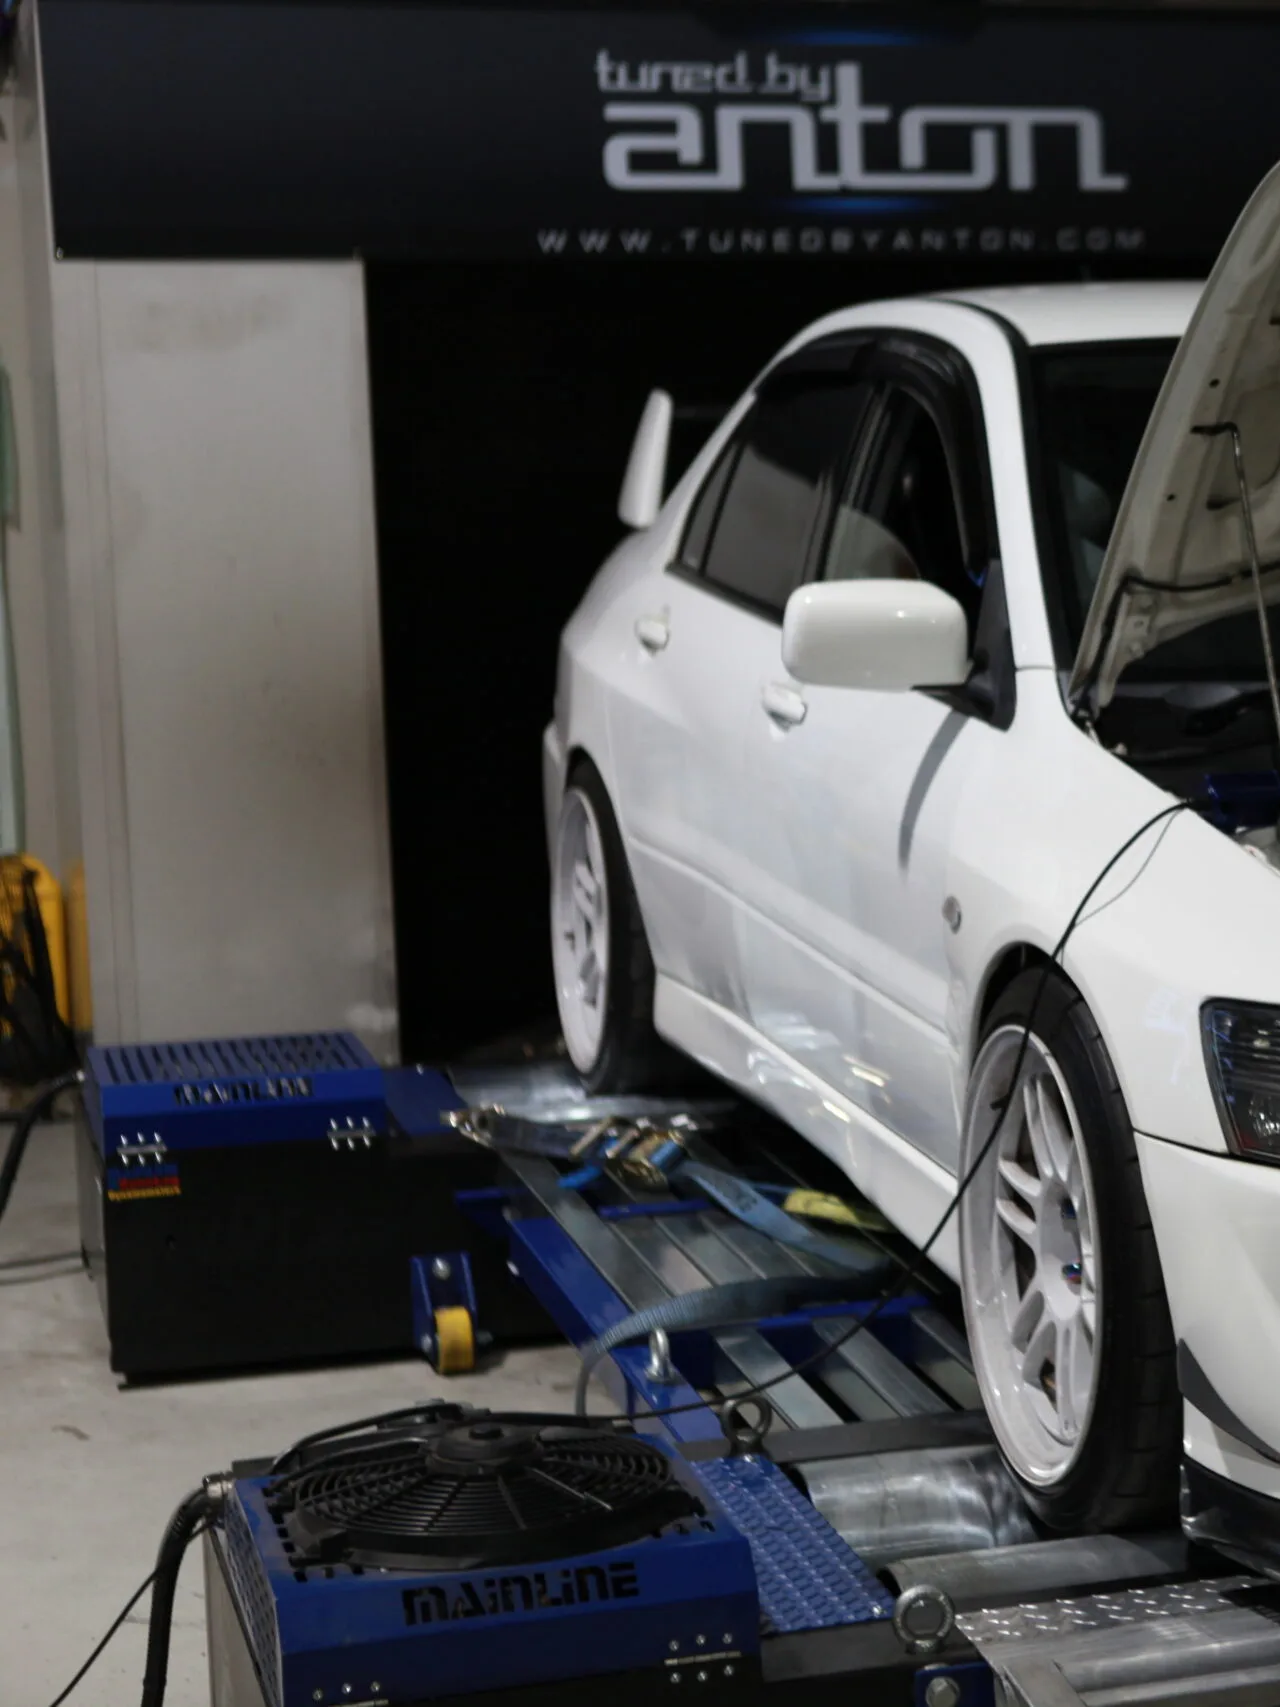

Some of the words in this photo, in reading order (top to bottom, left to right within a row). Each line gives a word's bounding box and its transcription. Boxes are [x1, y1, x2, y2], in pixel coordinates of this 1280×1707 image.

[594, 48, 753, 93] tuned
[757, 49, 832, 103] by
[603, 61, 1127, 190] anton
